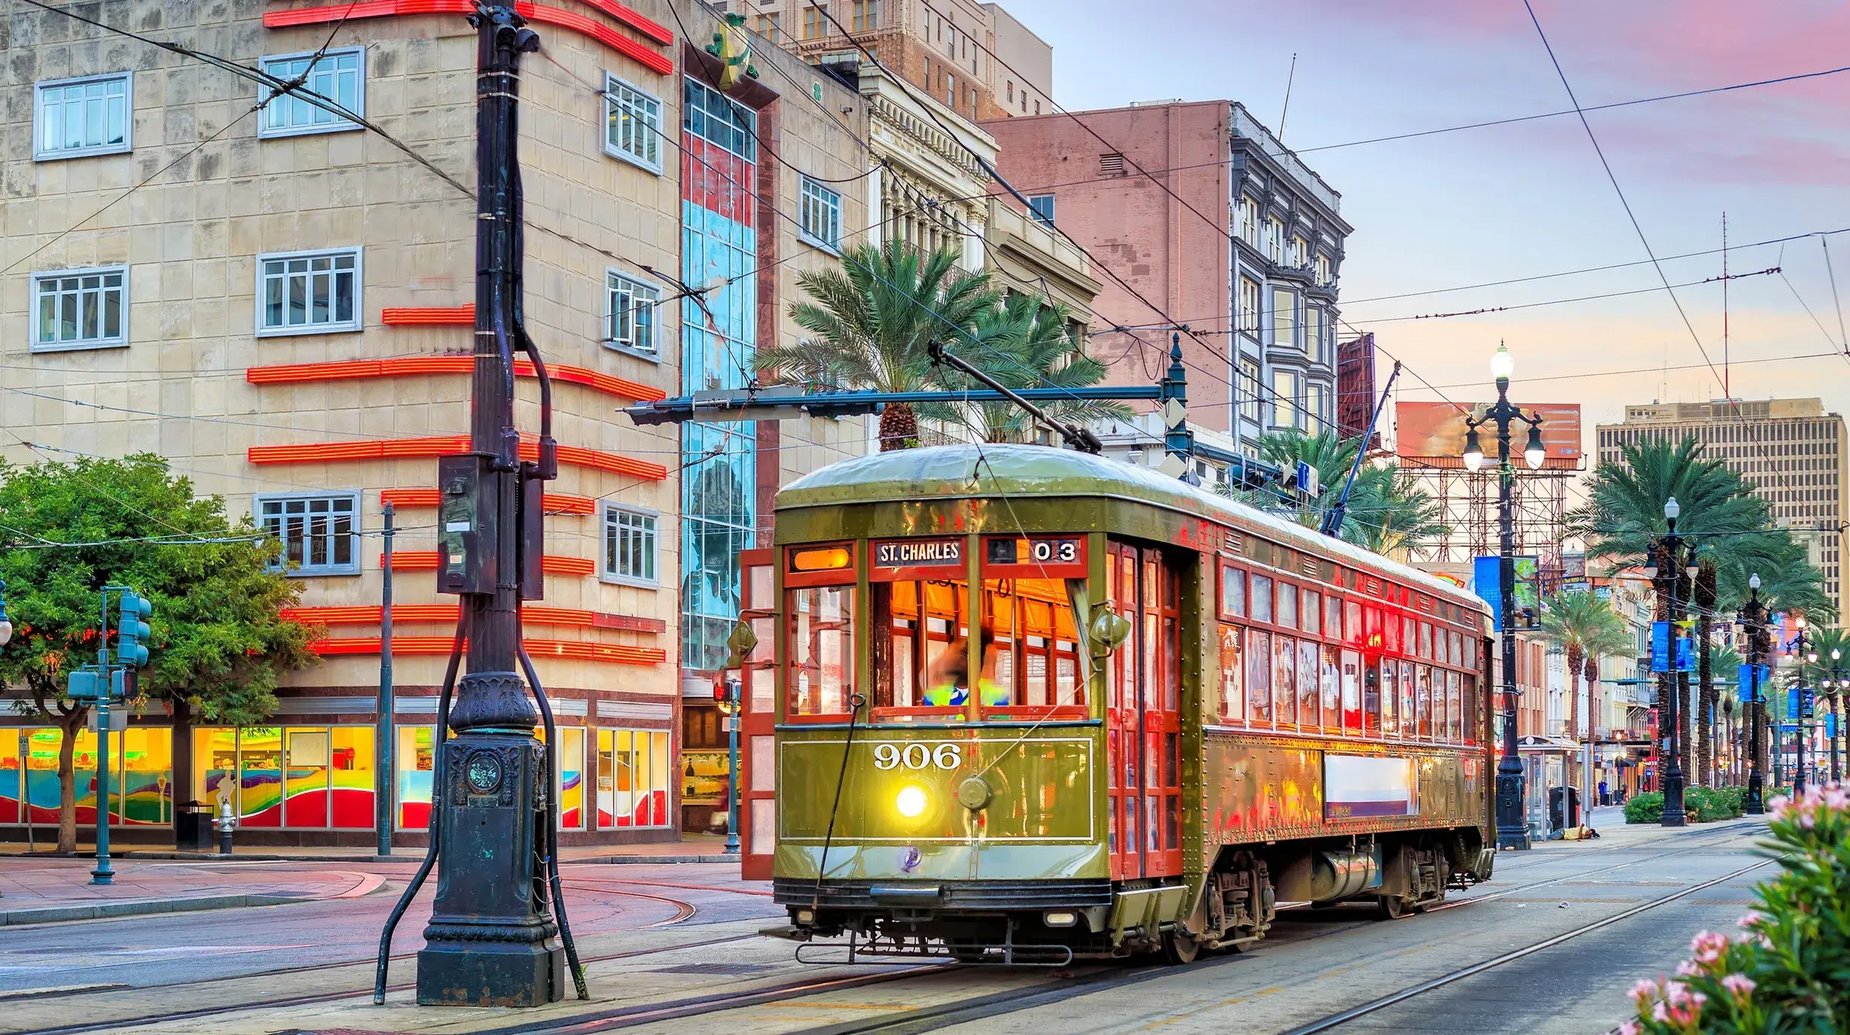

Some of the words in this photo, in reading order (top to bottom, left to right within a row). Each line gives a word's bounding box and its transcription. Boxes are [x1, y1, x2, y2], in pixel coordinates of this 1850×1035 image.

[880, 545, 898, 562] ST.
[900, 542, 959, 560] CHARLES
[874, 743, 962, 770] 906
